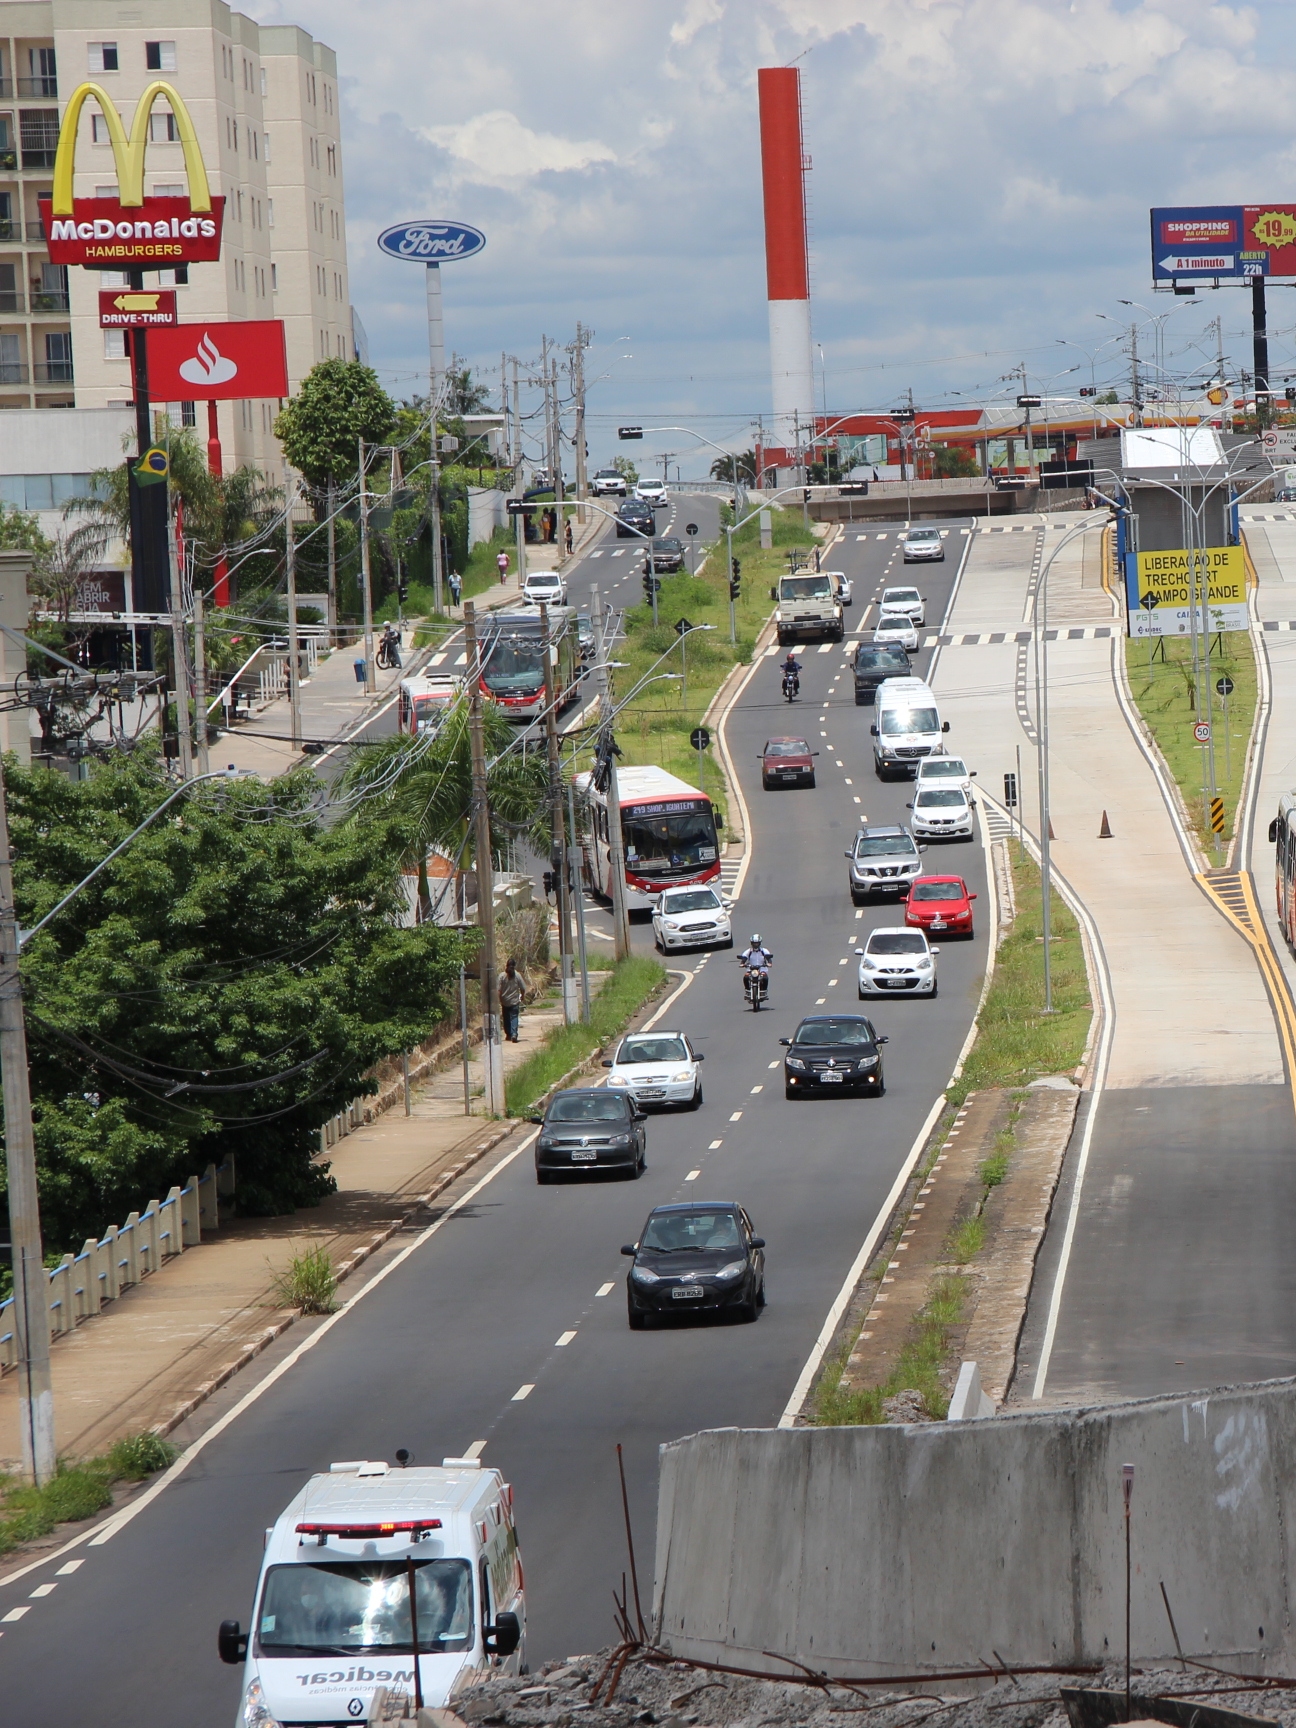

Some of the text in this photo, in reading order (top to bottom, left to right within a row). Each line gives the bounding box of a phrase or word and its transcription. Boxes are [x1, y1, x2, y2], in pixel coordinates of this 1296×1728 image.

[51, 217, 216, 241] McDonald's
[1167, 222, 1230, 231] SHOPPING
[398, 227, 466, 255] Ford
[86, 244, 183, 257] HAMBURGERS
[1239, 251, 1267, 260] ABERTO
[1176, 258, 1225, 268] A 1 minuto
[1243, 264, 1263, 275] 22h
[102, 313, 173, 324] DRIVE-THRU
[1213, 553, 1229, 566] DE
[75, 591, 111, 603] ABRIR
[1148, 589, 1188, 602] AMPO
[1197, 728, 1208, 736] 50
[647, 804, 666, 813] SHOP.
